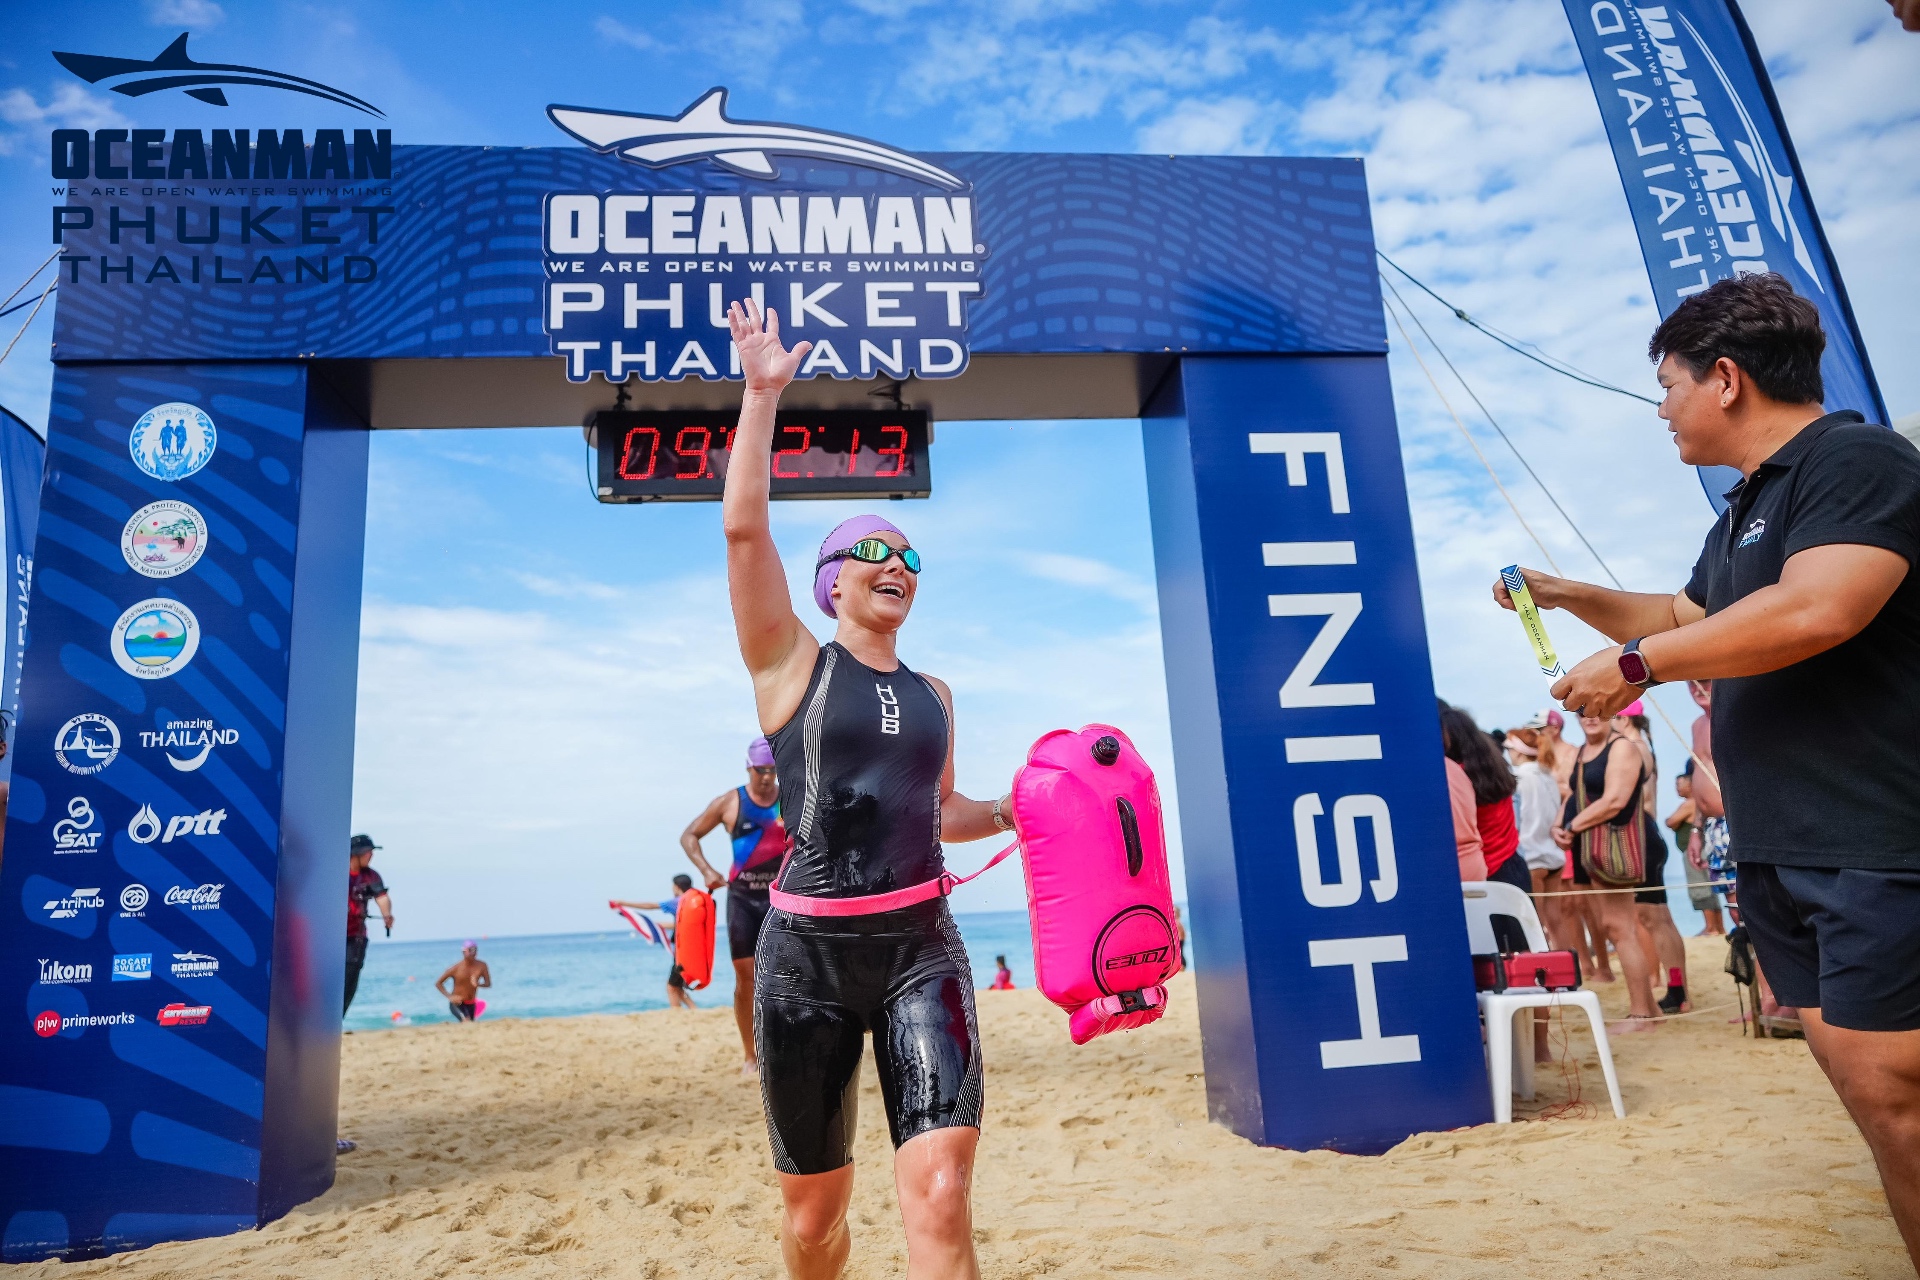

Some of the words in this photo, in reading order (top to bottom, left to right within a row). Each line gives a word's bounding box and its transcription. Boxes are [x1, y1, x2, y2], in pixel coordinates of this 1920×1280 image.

[549, 195, 975, 255] OCEANMAN
[550, 261, 585, 273] WE
[600, 261, 651, 273] ARE
[665, 261, 733, 273] OPEN
[748, 261, 833, 273] WATER
[847, 260, 976, 273] SWIMMING
[166, 717, 214, 730] amazing
[139, 728, 240, 748] THAILAND
[1248, 431, 1422, 1069] FINISH
[162, 808, 228, 844] ptt
[55, 832, 102, 848] SAT
[61, 896, 105, 909] trihub
[114, 957, 151, 965] POCARI
[171, 961, 219, 972] OCEANMAN
[62, 1012, 135, 1029] primeworks
